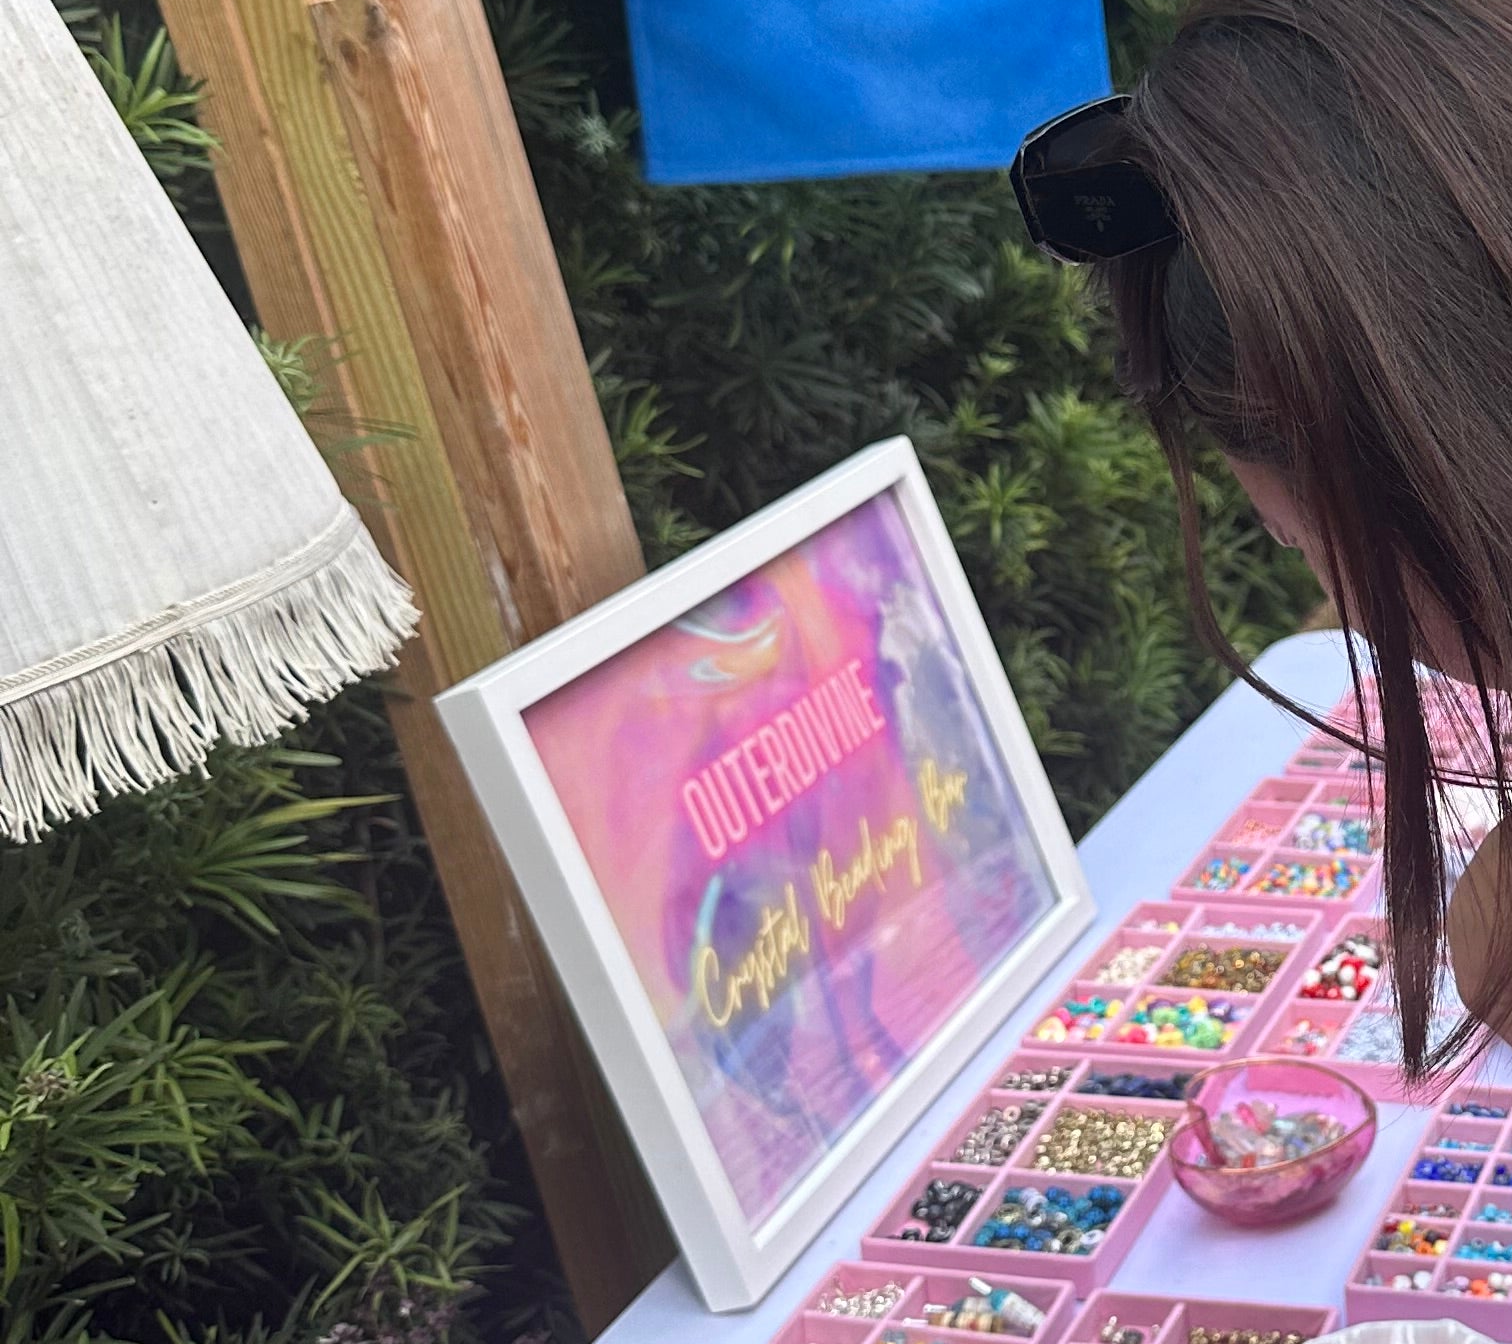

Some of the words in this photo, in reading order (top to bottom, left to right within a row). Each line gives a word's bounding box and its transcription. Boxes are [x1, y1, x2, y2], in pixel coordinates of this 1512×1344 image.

[682, 660, 887, 858] OUTERDIVINE
[701, 882, 810, 1027] Crystal
[809, 816, 922, 930] Beading
[918, 758, 968, 833] Bar
